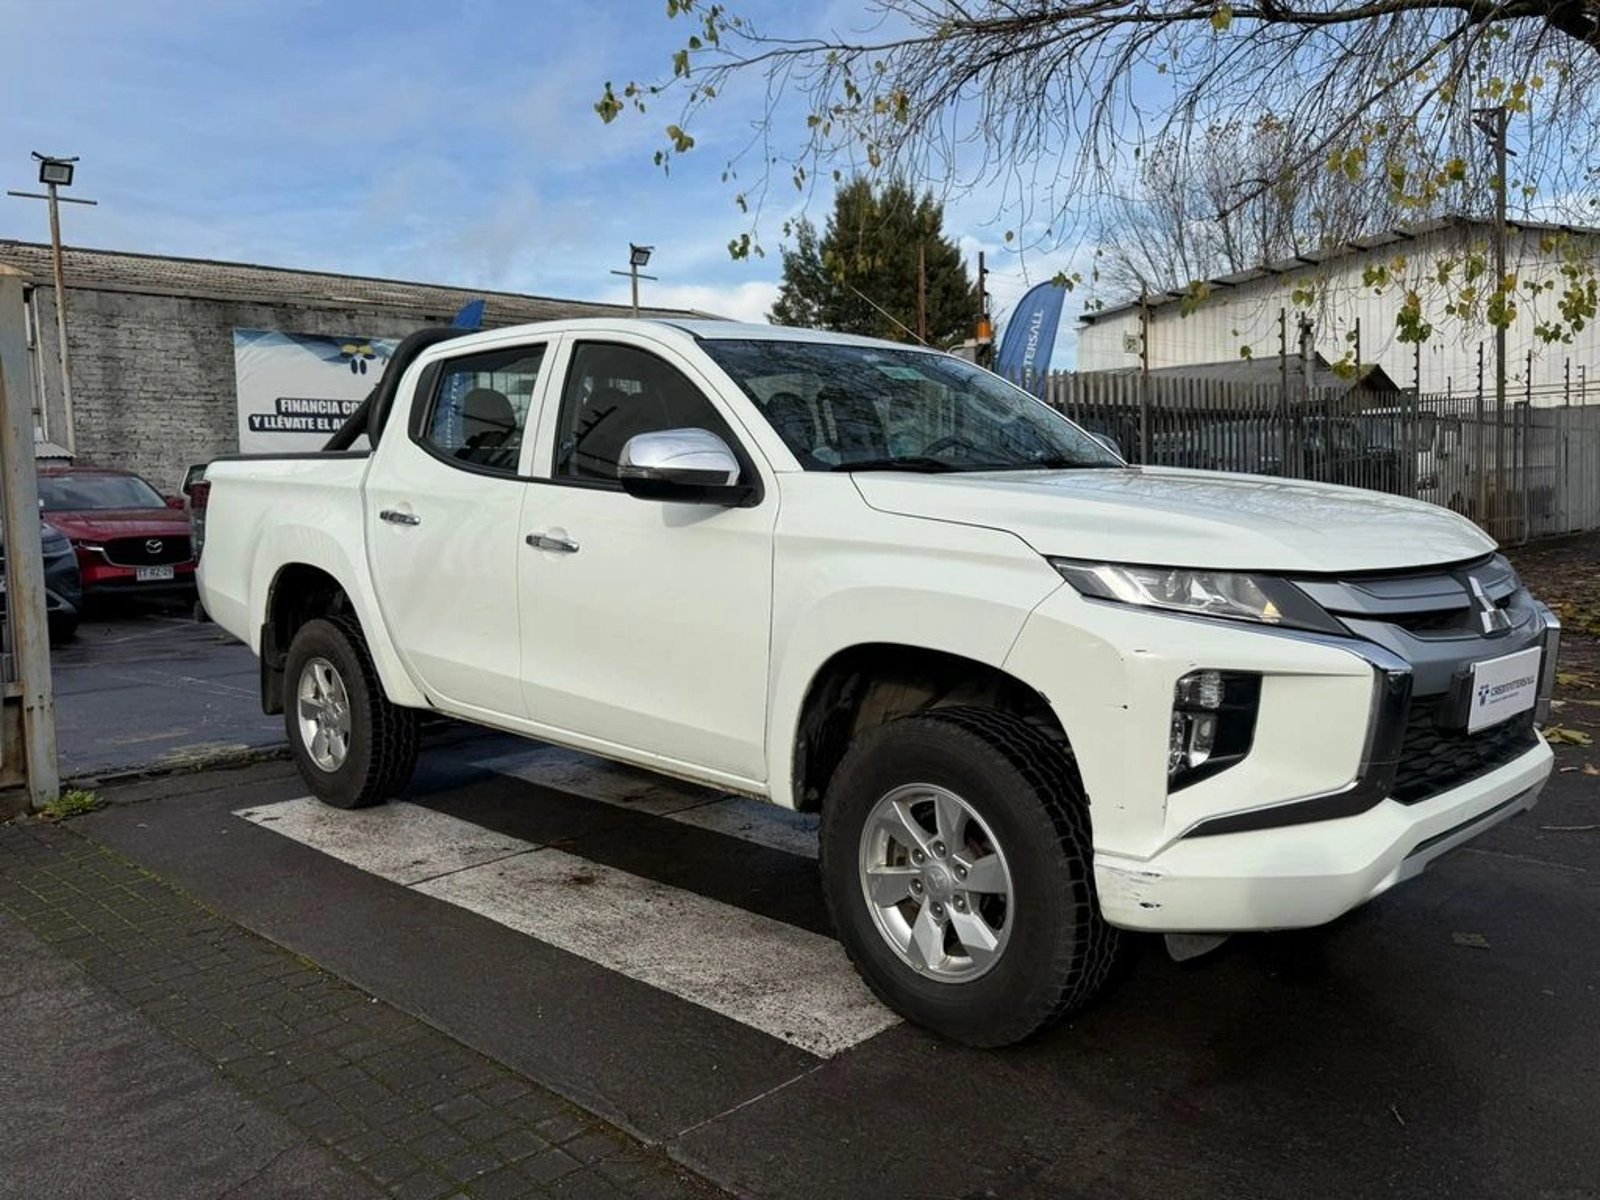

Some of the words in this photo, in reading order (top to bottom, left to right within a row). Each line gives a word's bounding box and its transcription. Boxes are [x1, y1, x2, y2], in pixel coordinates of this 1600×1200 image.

[280, 399, 340, 414] FINANCIA
[342, 401, 362, 414] CO
[252, 416, 262, 428] Y
[263, 414, 315, 429] LLÉVATE
[317, 418, 330, 429] EL
